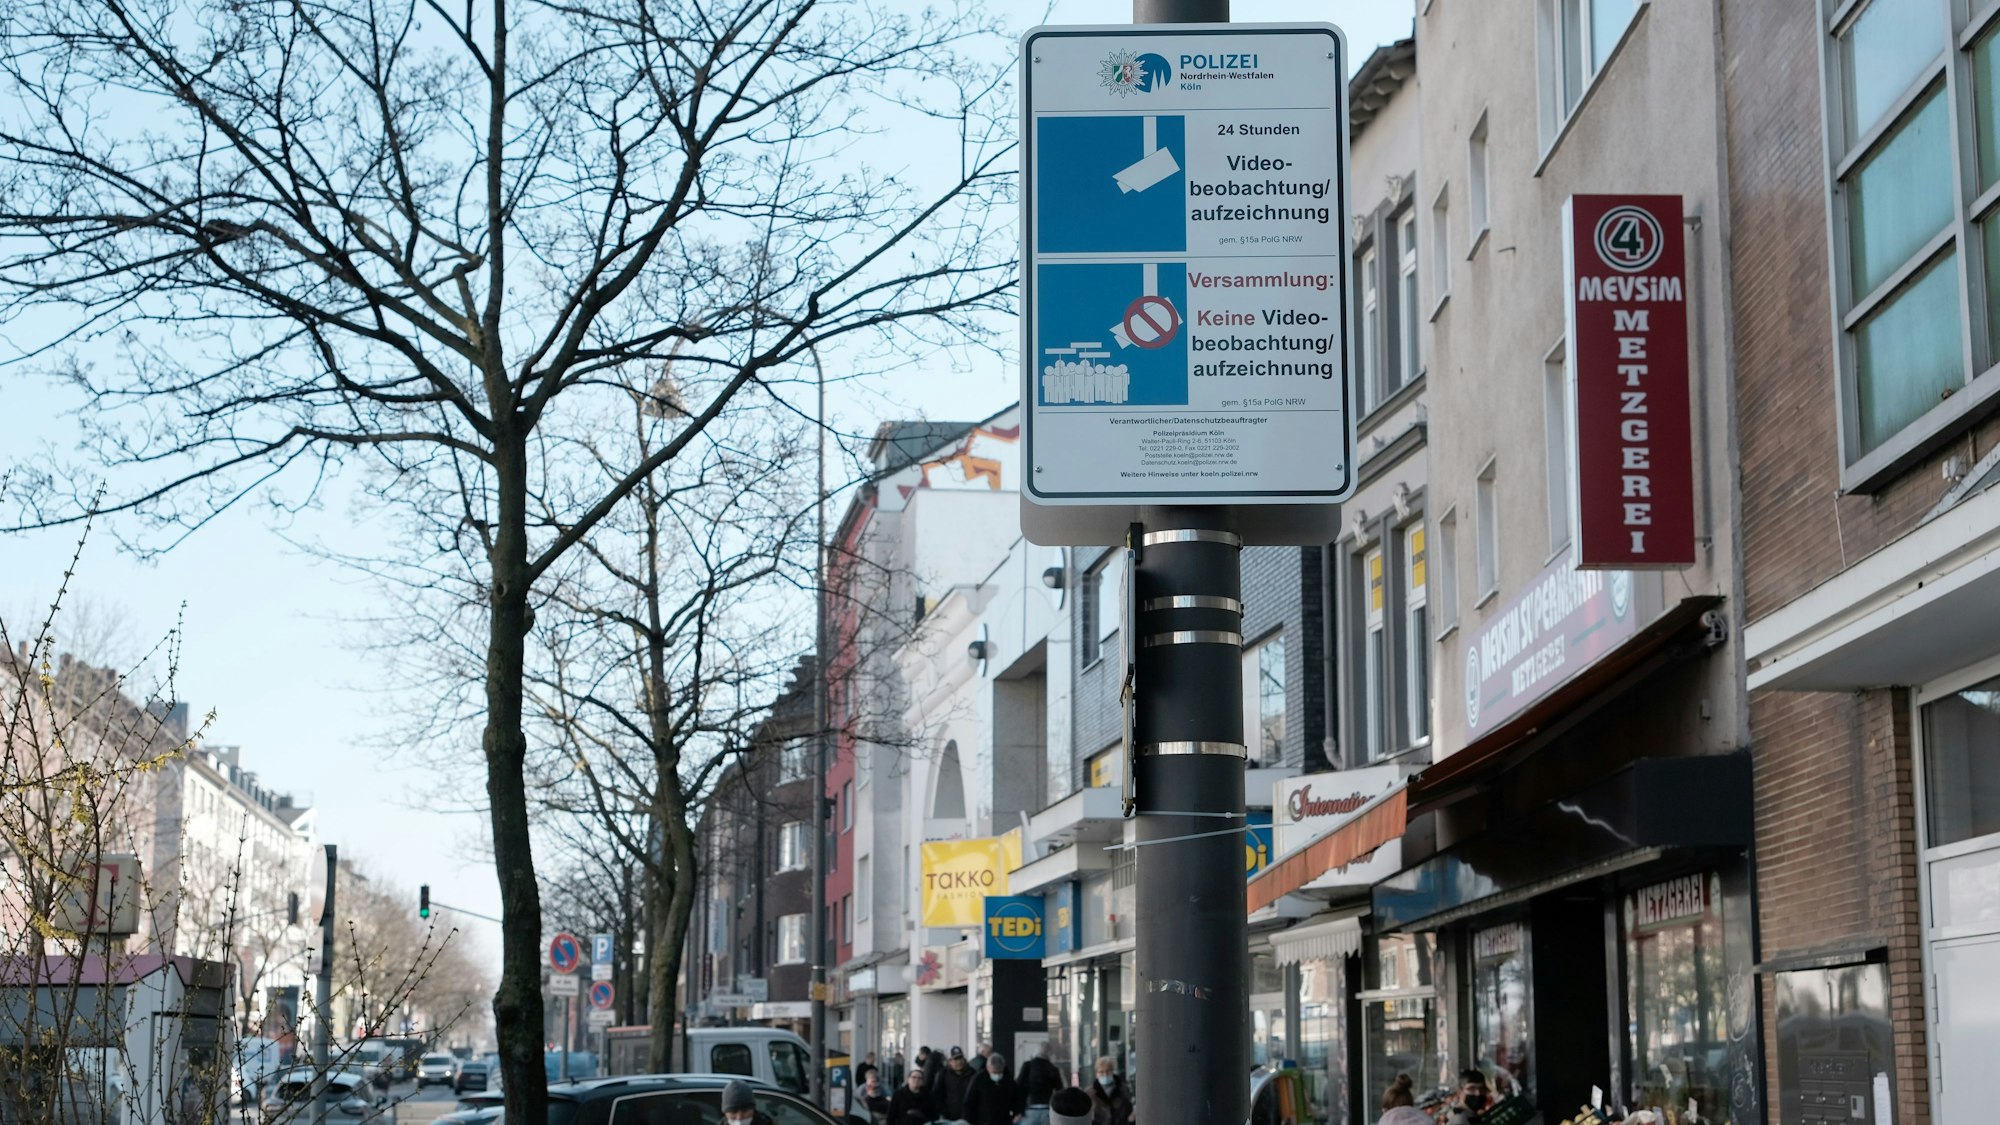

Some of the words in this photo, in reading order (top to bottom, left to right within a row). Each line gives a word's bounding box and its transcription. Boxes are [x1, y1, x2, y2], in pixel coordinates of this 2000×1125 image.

[1180, 54, 1258, 69] POLIZEI
[1180, 72, 1274, 80] Nordrhein-Westfalen
[1180, 83, 1202, 91] Köln
[1218, 124, 1235, 136] 24
[1239, 124, 1300, 136] Stunden
[1226, 155, 1293, 171] Video-
[1189, 179, 1331, 200] beobachtung/
[1191, 205, 1329, 223] aufzeichnung
[1219, 237, 1238, 245] gem.
[1240, 235, 1259, 244] §15a
[1283, 235, 1303, 243] NRW
[1606, 216, 1644, 260] 4
[1188, 272, 1334, 291] Versammlung:
[1197, 310, 1256, 326] Keine
[1261, 309, 1329, 325] Video-
[1192, 334, 1334, 355] beobachtung/
[1193, 360, 1333, 379] aufzeichnung
[1243, 398, 1262, 408] §15a
[1285, 398, 1306, 406] NRW
[1109, 417, 1268, 425] Verantwortlicher/Datenschutzbeauftragter
[1613, 309, 1652, 554] METZGEREI
[1637, 873, 1704, 925] METZGEREI
[988, 917, 1042, 937] TEDi
[596, 938, 609, 961] P
